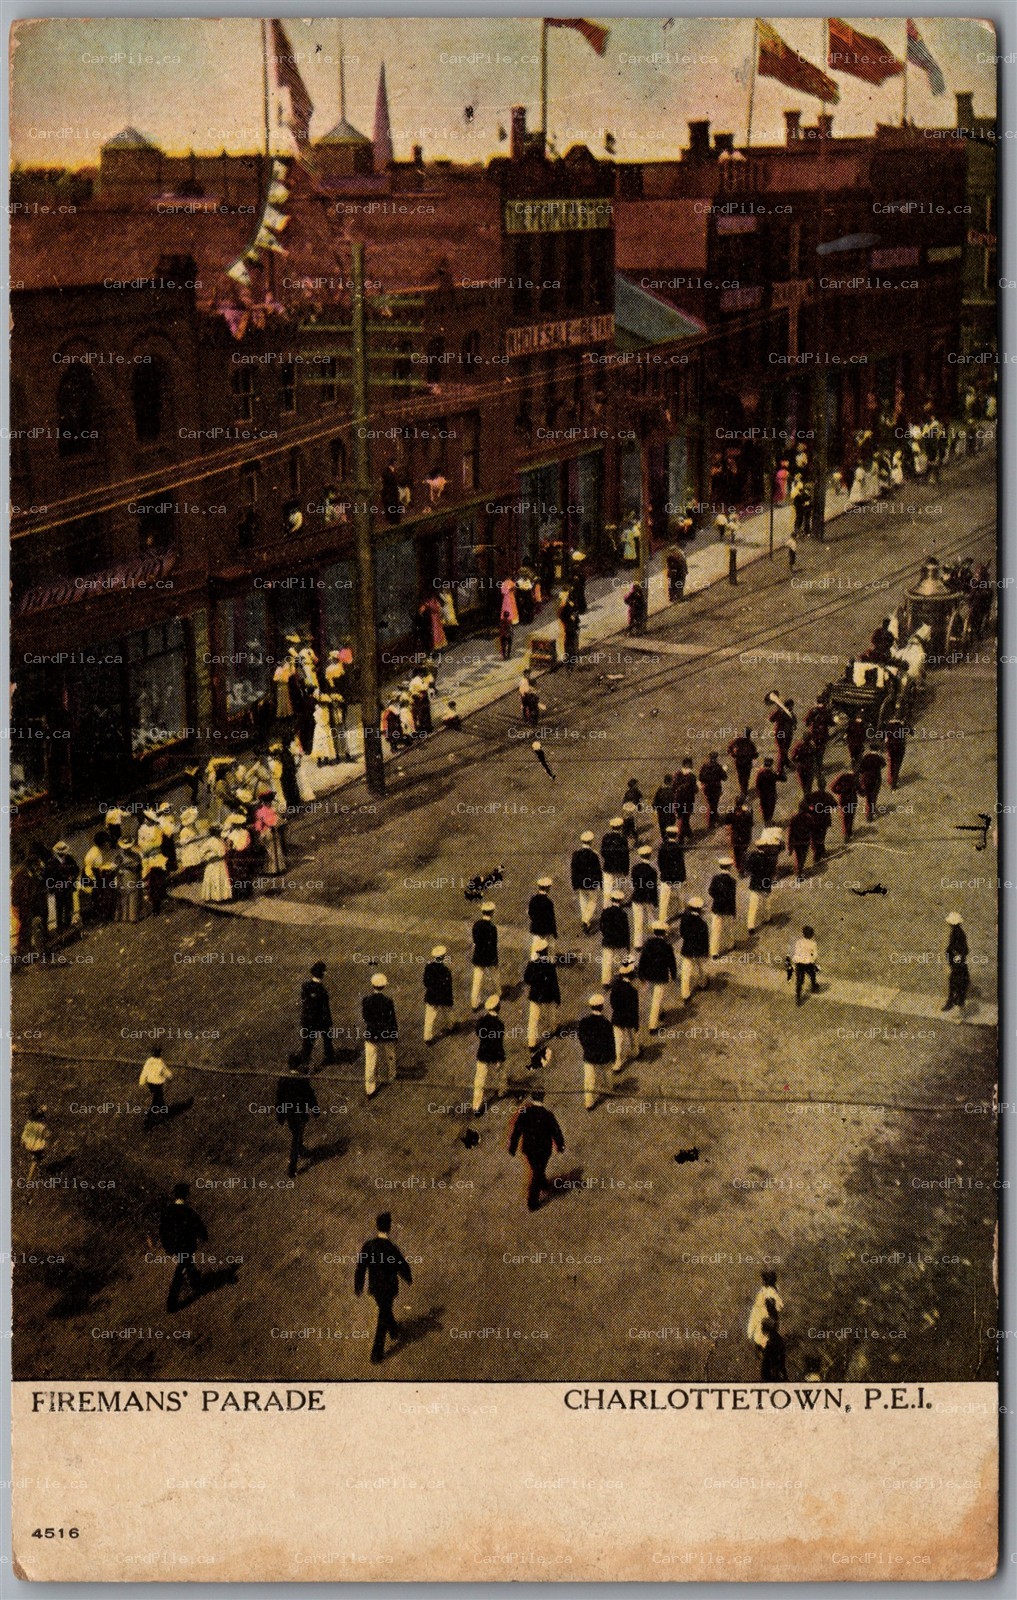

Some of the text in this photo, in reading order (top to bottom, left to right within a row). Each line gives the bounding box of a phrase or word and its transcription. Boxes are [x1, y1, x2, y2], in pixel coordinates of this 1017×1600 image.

[32, 1390, 325, 1412] FIREMANS' PARADE
[564, 1388, 931, 1412] CHARLOTTETOWN, P.E.I.
[32, 1528, 79, 1538] 4516
